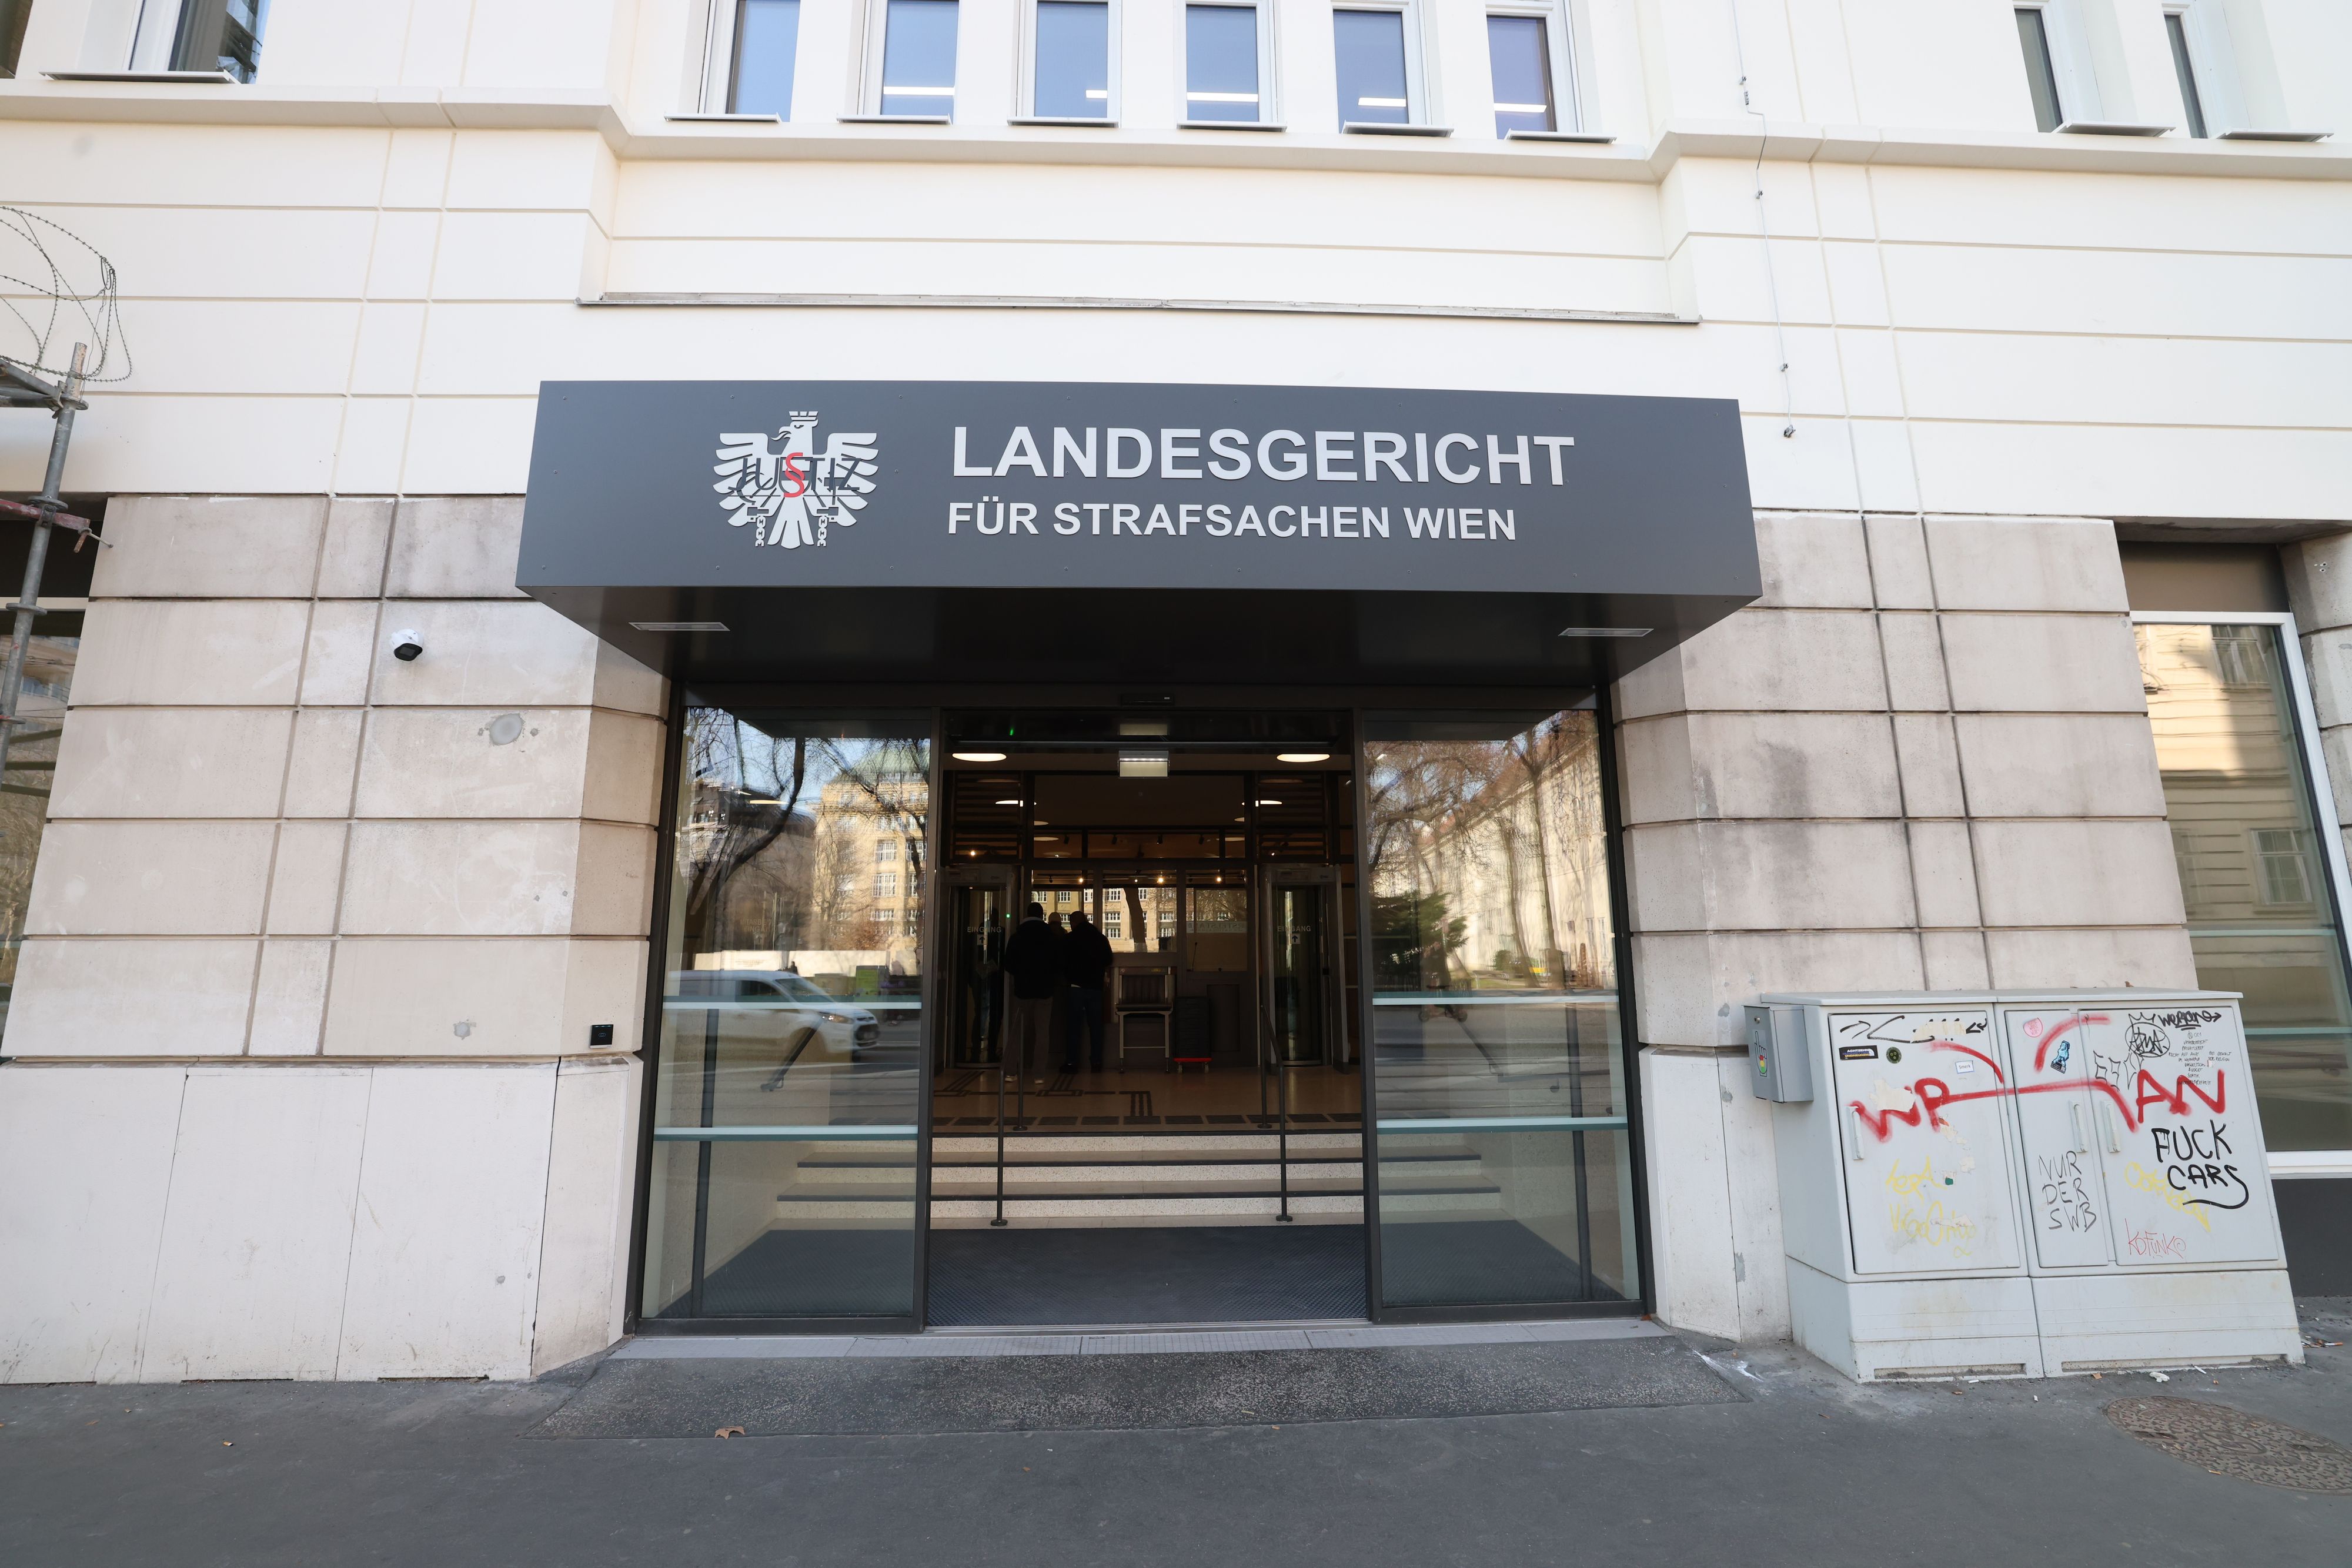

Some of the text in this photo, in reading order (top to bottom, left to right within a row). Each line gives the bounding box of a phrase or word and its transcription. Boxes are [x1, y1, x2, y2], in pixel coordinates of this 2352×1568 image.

[953, 426, 1575, 486] LANDESGERICHT
[948, 495, 1516, 541] FÜR STRAFSACHEN WIEN
[2151, 1119, 2233, 1163] FUCK
[2038, 1150, 2082, 1181] NUR
[2167, 1164, 2249, 1209] CARS
[2042, 1177, 2089, 1206] DER
[2048, 1201, 2097, 1233] SWB
